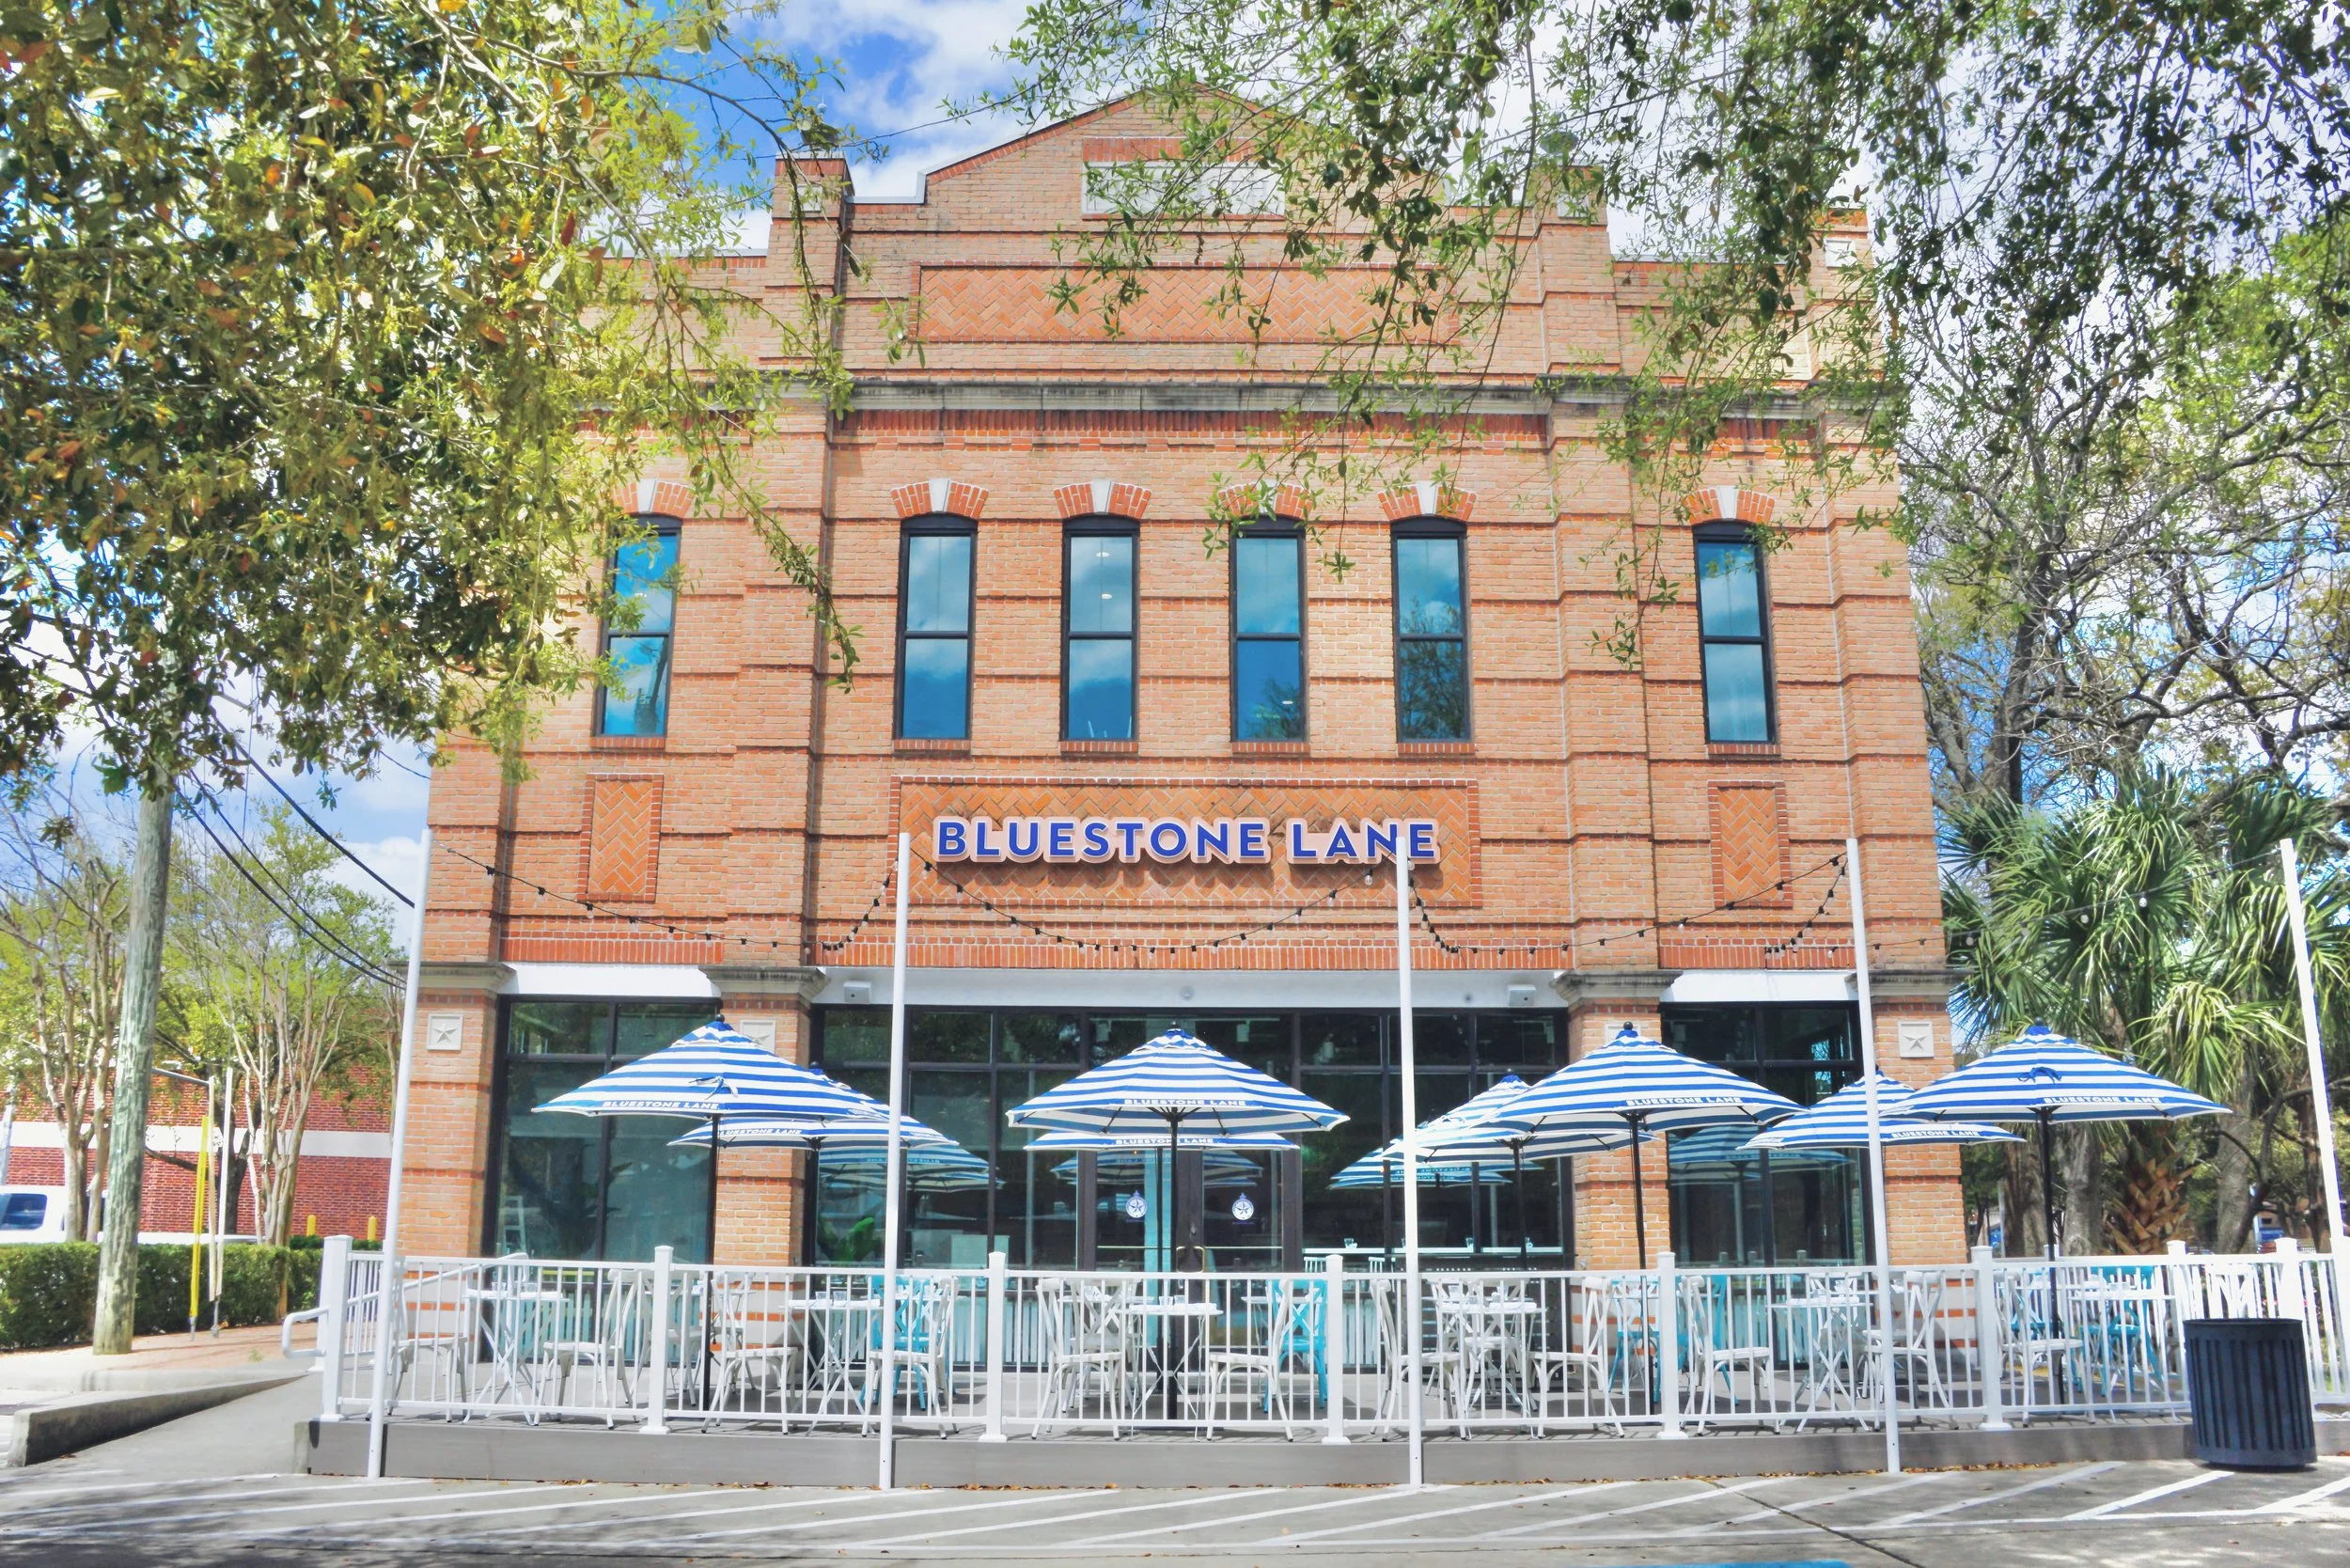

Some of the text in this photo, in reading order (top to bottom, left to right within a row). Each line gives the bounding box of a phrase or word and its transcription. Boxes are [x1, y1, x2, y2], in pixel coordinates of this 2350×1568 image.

[937, 819, 1436, 860] BLUESTONE LANE
[1625, 1097, 1703, 1106] BLUESTONE
[2043, 1096, 2122, 1105] BLUESTONE
[603, 1101, 720, 1111] BLUESTONE LANE
